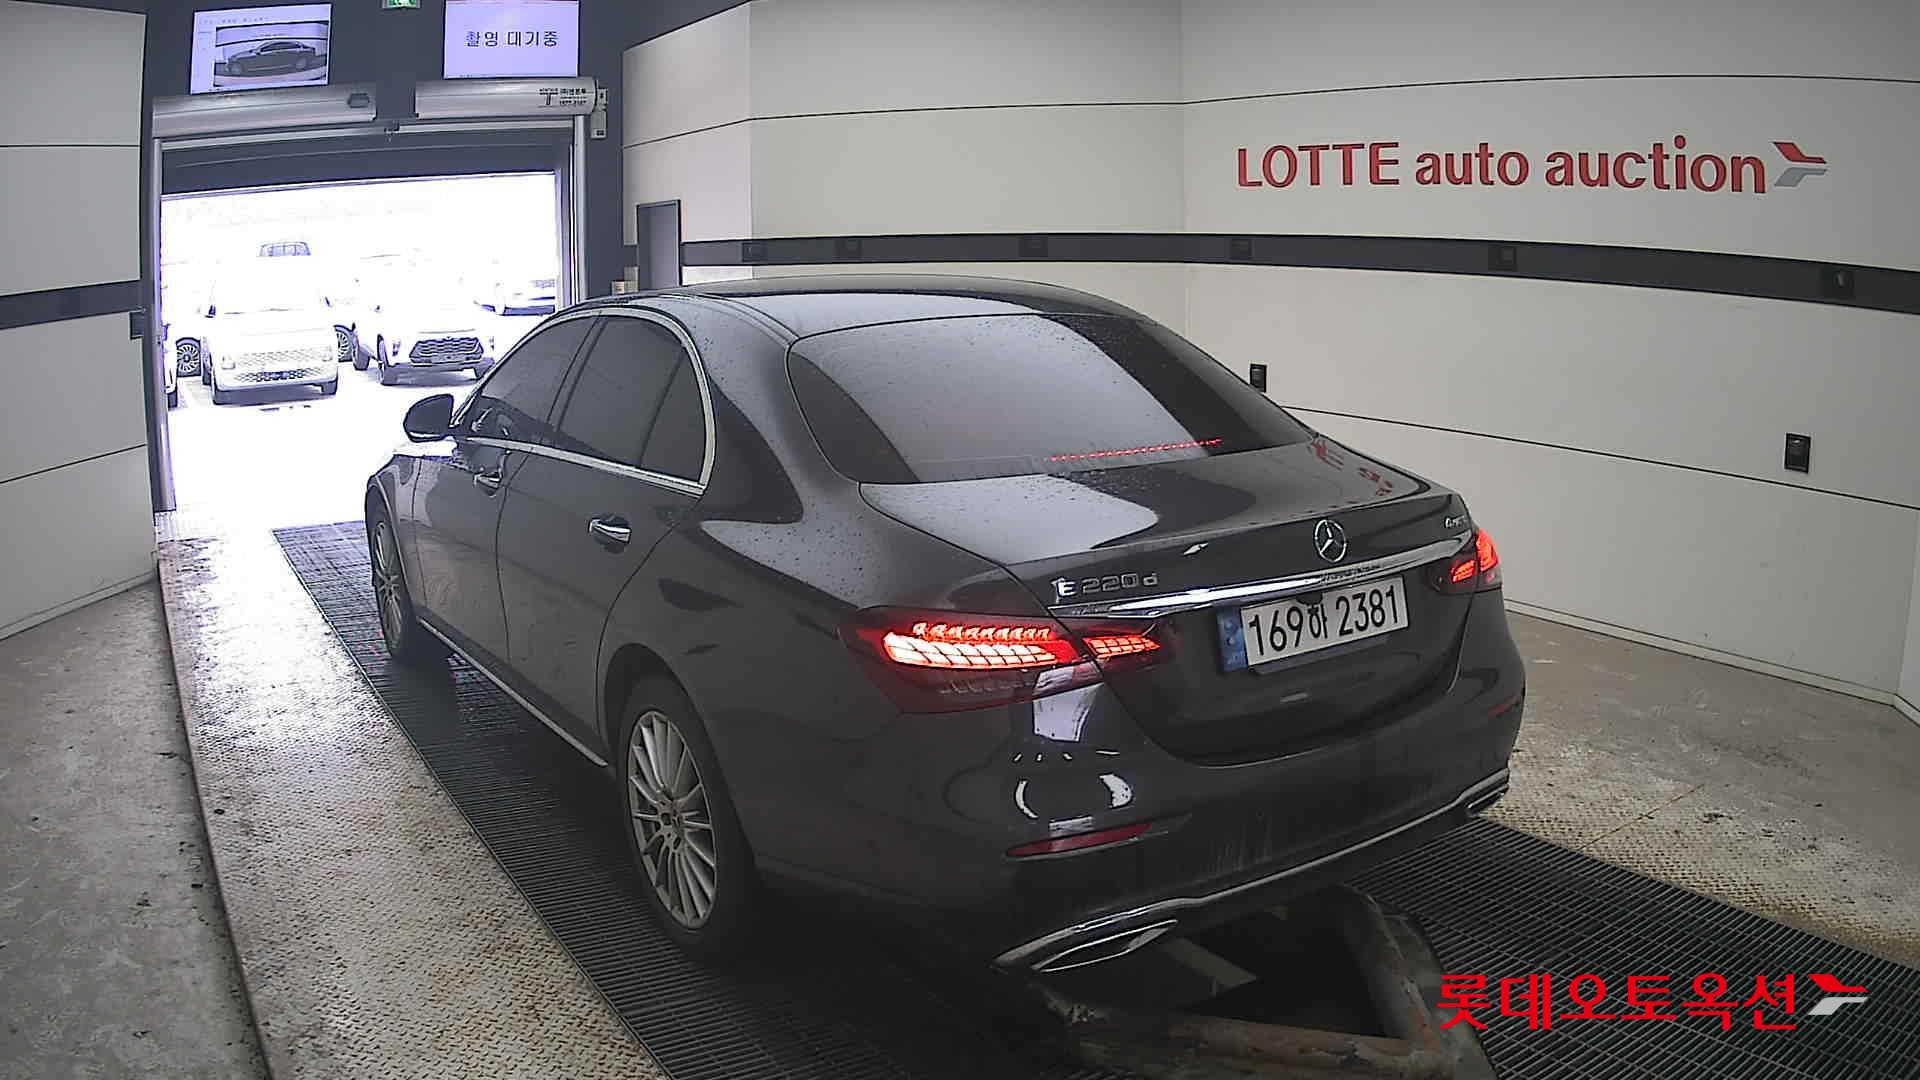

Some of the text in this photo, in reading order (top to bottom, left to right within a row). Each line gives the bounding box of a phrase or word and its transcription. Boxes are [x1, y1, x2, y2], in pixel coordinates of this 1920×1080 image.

[507, 31, 558, 47] 대기중
[1238, 135, 1766, 194] LOTTE auto auction
[1249, 585, 1398, 656] 169하 2381
